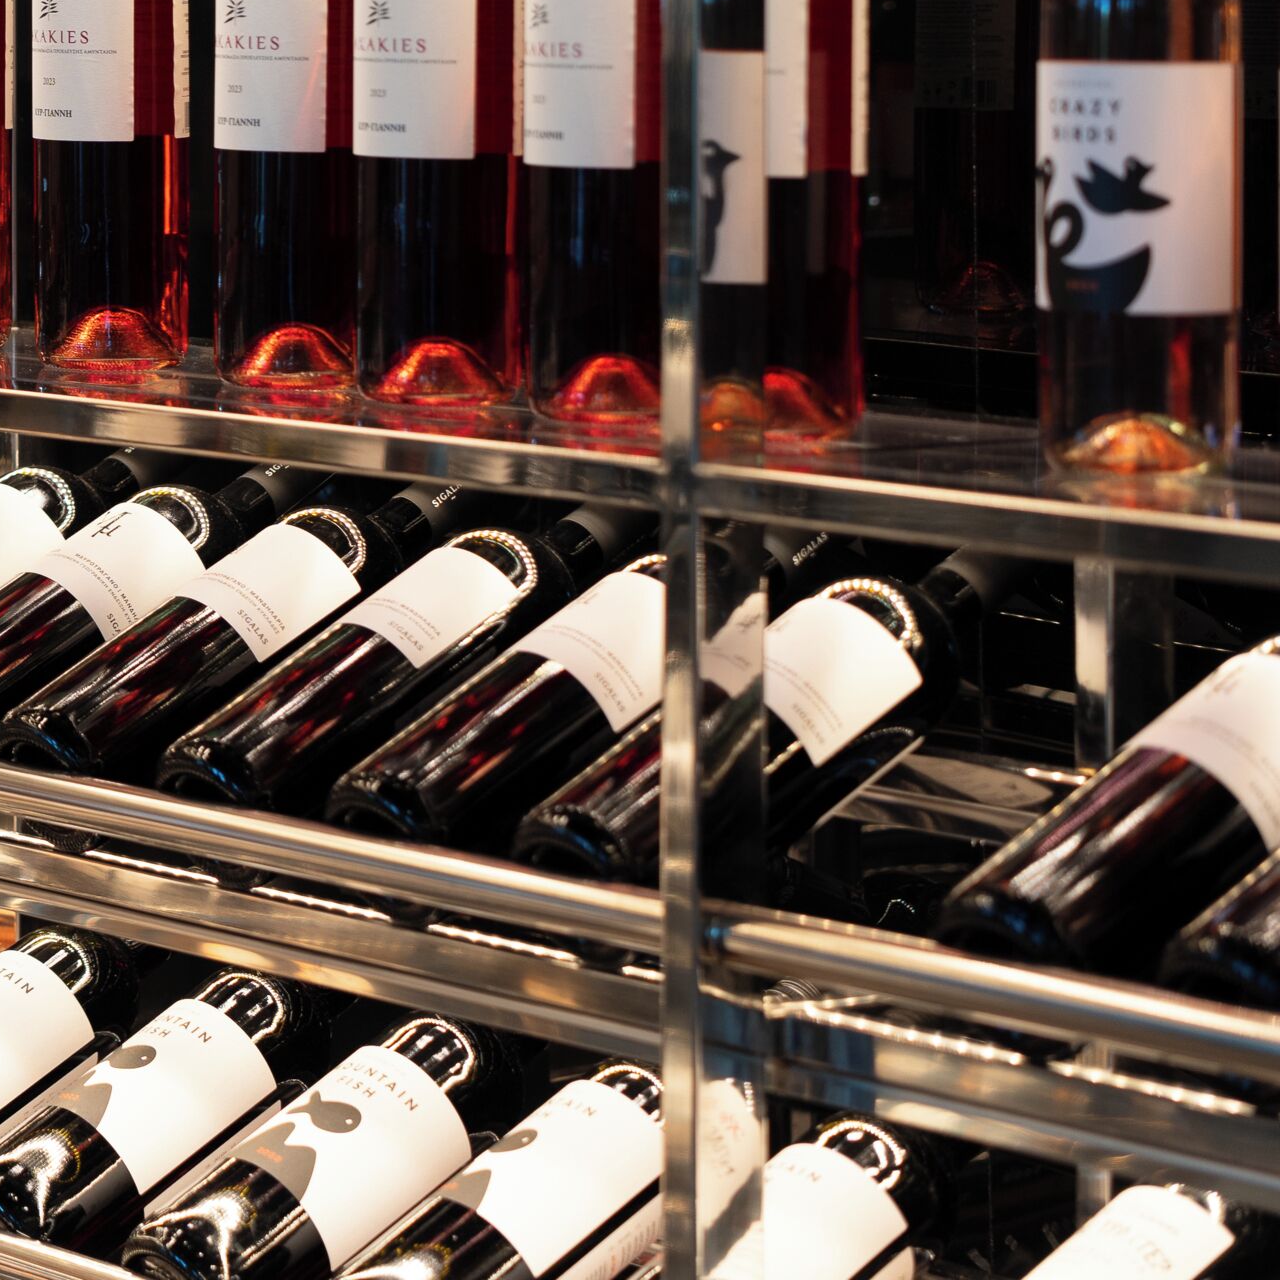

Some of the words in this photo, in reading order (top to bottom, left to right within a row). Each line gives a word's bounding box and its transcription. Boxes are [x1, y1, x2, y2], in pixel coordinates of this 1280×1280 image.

[792, 531, 828, 566] SIGALAS
[237, 609, 268, 645] SIGALAS
[388, 621, 423, 651] SIGALAS
